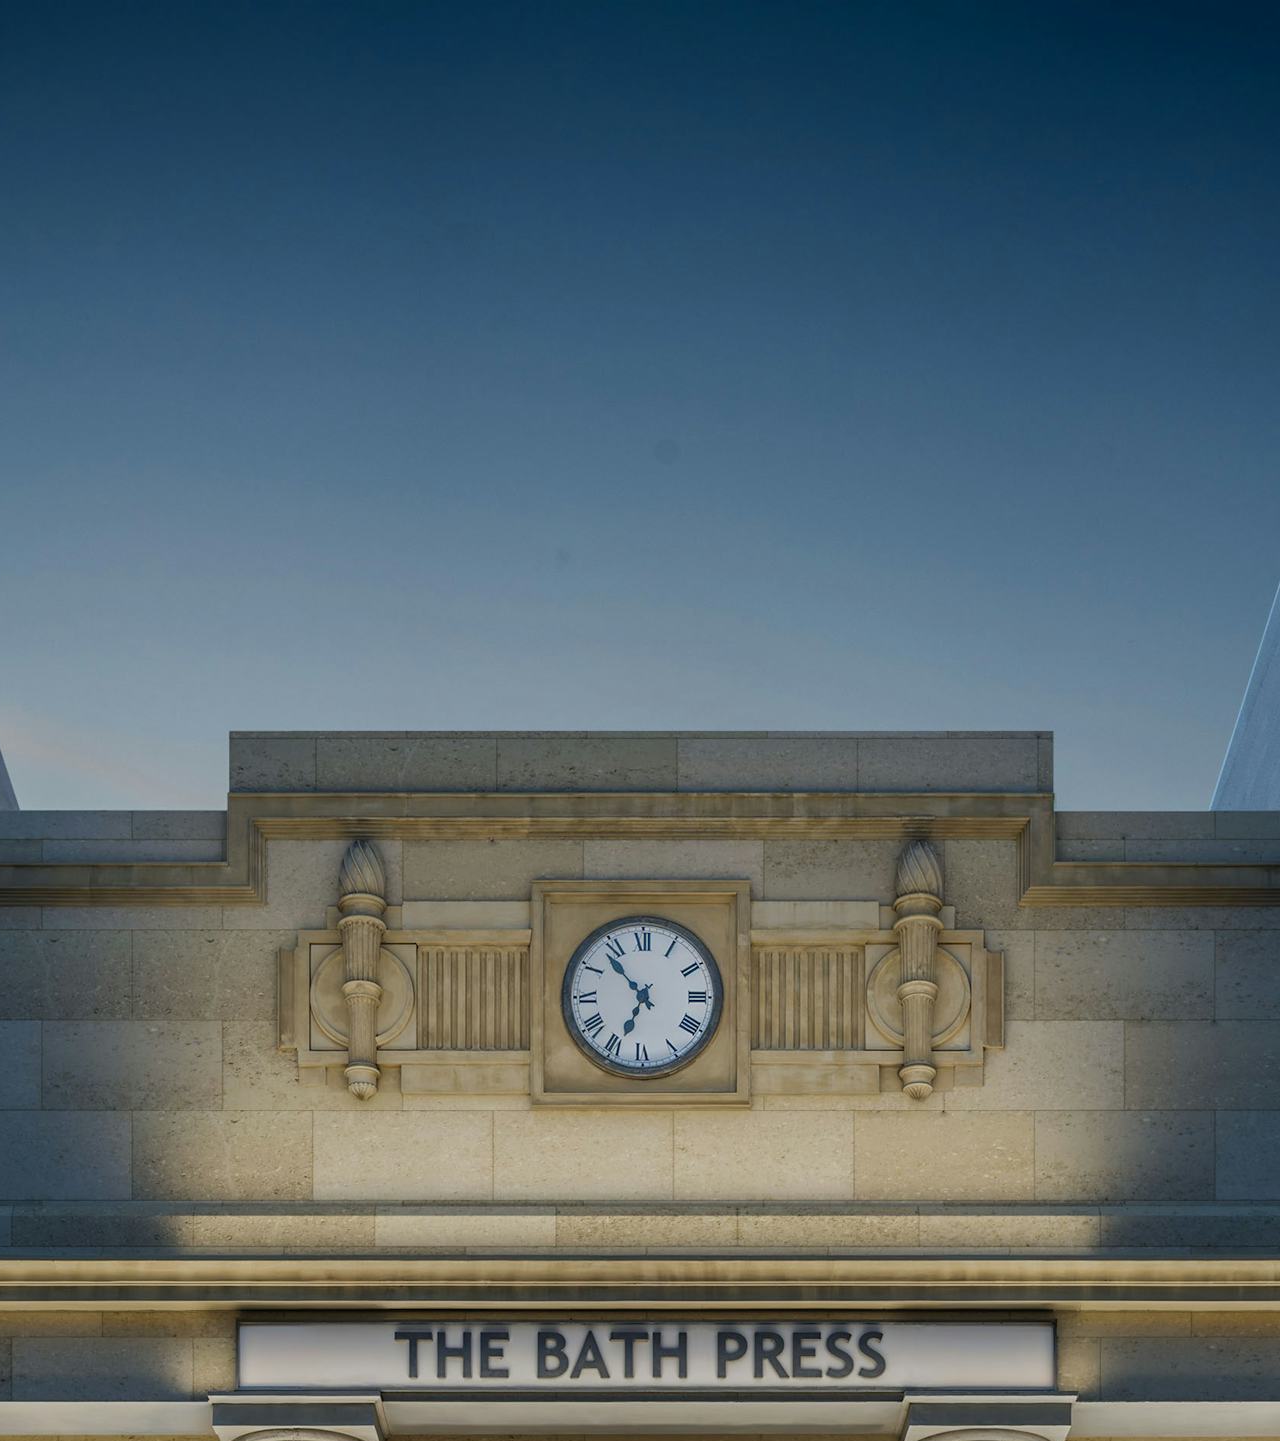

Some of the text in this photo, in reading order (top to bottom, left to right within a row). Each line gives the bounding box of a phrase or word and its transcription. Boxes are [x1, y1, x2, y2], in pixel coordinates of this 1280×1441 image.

[680, 961, 700, 978] II
[687, 990, 707, 1004] III
[394, 1330, 886, 1378] THE BATH PRESS
